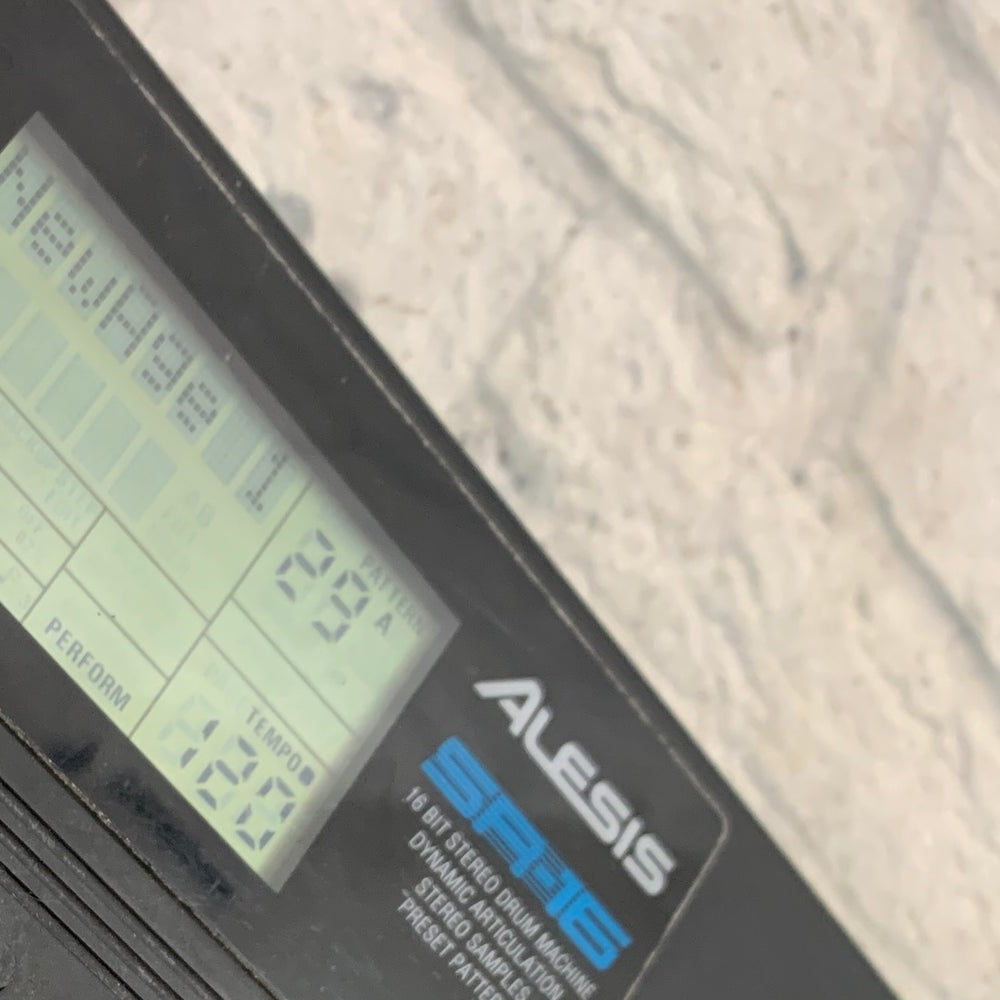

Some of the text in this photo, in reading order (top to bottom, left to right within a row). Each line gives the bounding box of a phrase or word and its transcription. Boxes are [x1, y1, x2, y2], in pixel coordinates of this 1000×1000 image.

[245, 452, 288, 512] 1
[275, 529, 392, 643] 29 A
[44, 616, 132, 713] PERFORM
[179, 719, 296, 850] 120
[246, 706, 303, 772] TEMPO
[473, 677, 676, 897] ALESIS
[405, 786, 597, 1000] 16 BIT STEREO DRUM MACHINE
[408, 830, 477, 904] DYNAMIC
[420, 735, 633, 970] SR-16
[398, 896, 455, 958] PRESET
[414, 876, 471, 938] STEREO
